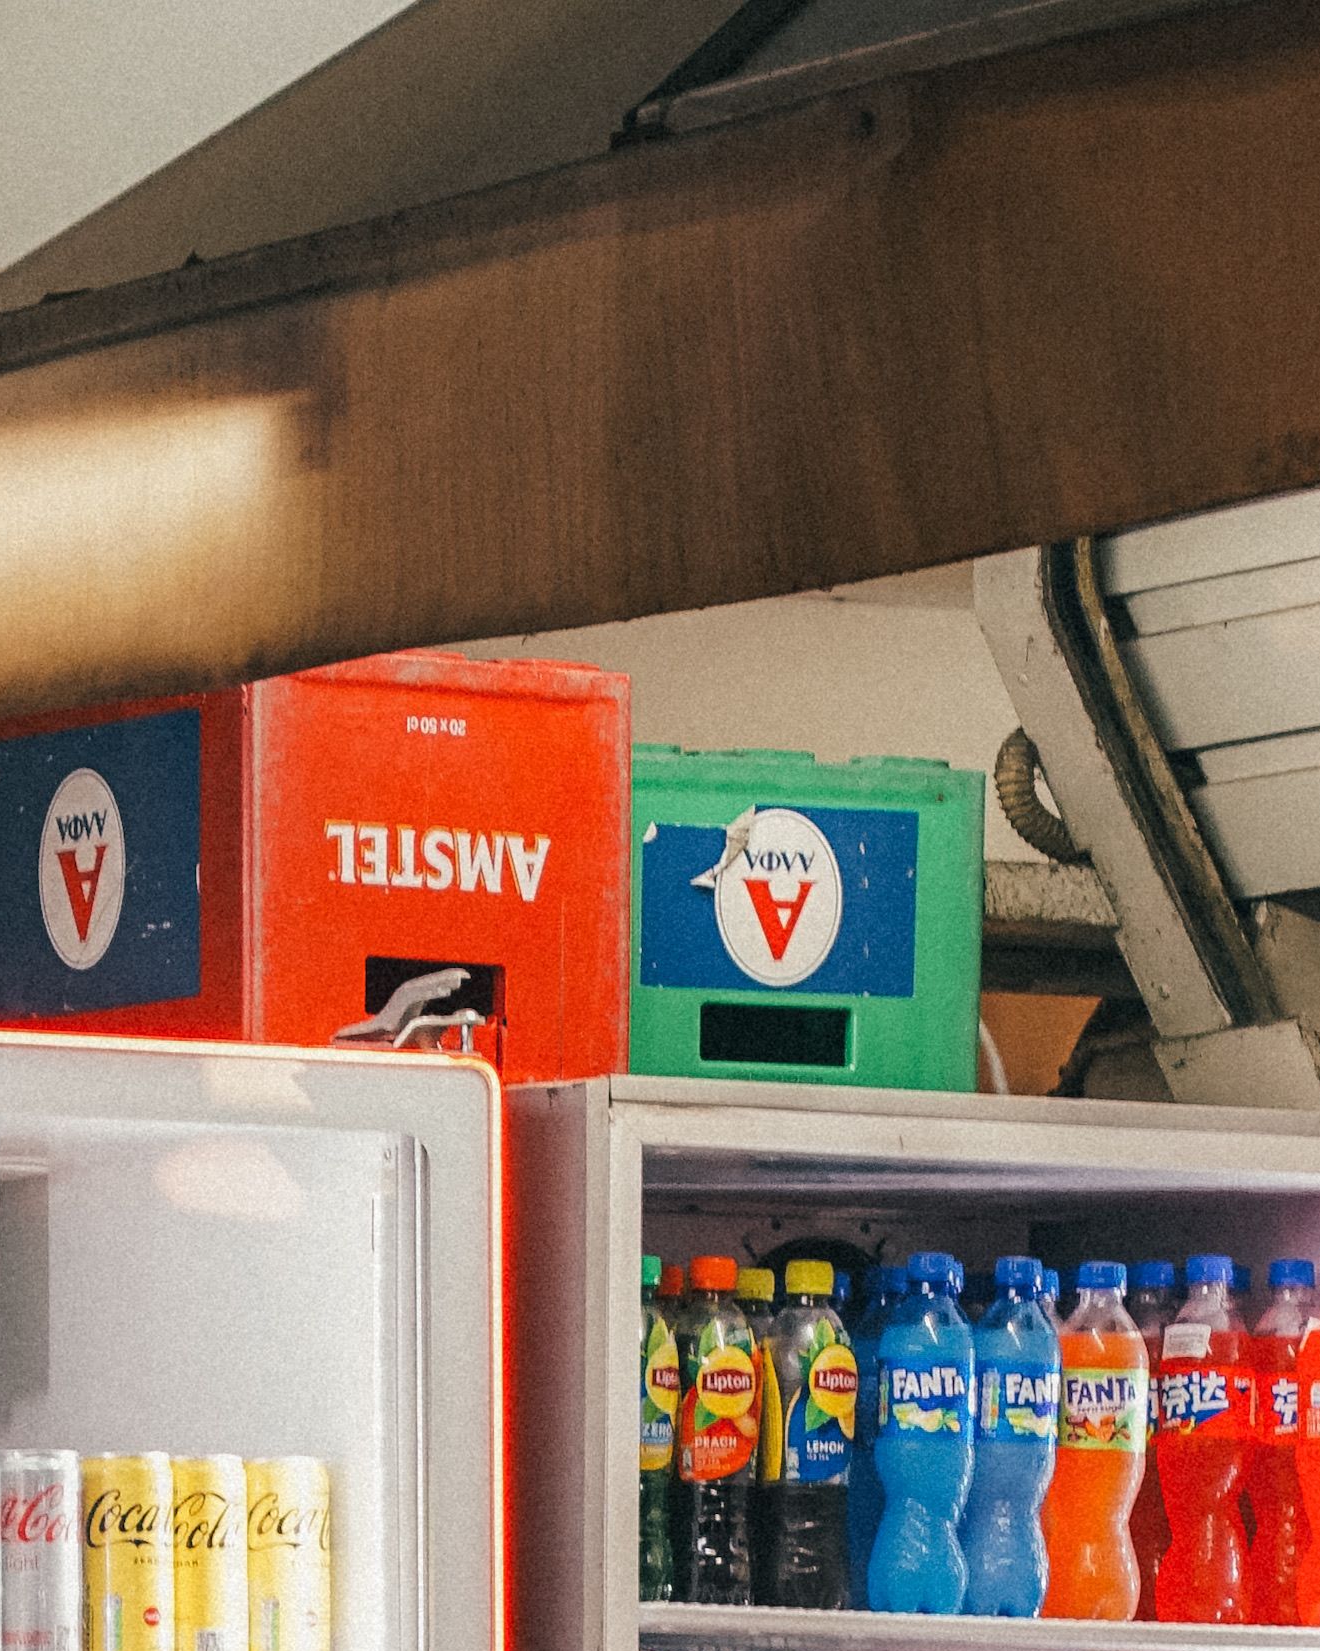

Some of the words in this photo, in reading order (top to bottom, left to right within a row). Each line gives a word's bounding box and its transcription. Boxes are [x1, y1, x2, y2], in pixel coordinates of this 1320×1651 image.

[420, 716, 438, 735] 50
[440, 718, 448, 733] x
[448, 718, 467, 736] 20
[325, 818, 550, 902] AMSTEL
[741, 847, 816, 874] ΑΛΦΑ
[705, 1371, 751, 1392] Lipton
[817, 1370, 856, 1391] Lipton
[892, 1366, 966, 1401] FANTA
[1066, 1375, 1137, 1405] FANTA
[806, 1439, 845, 1455] LEMON
